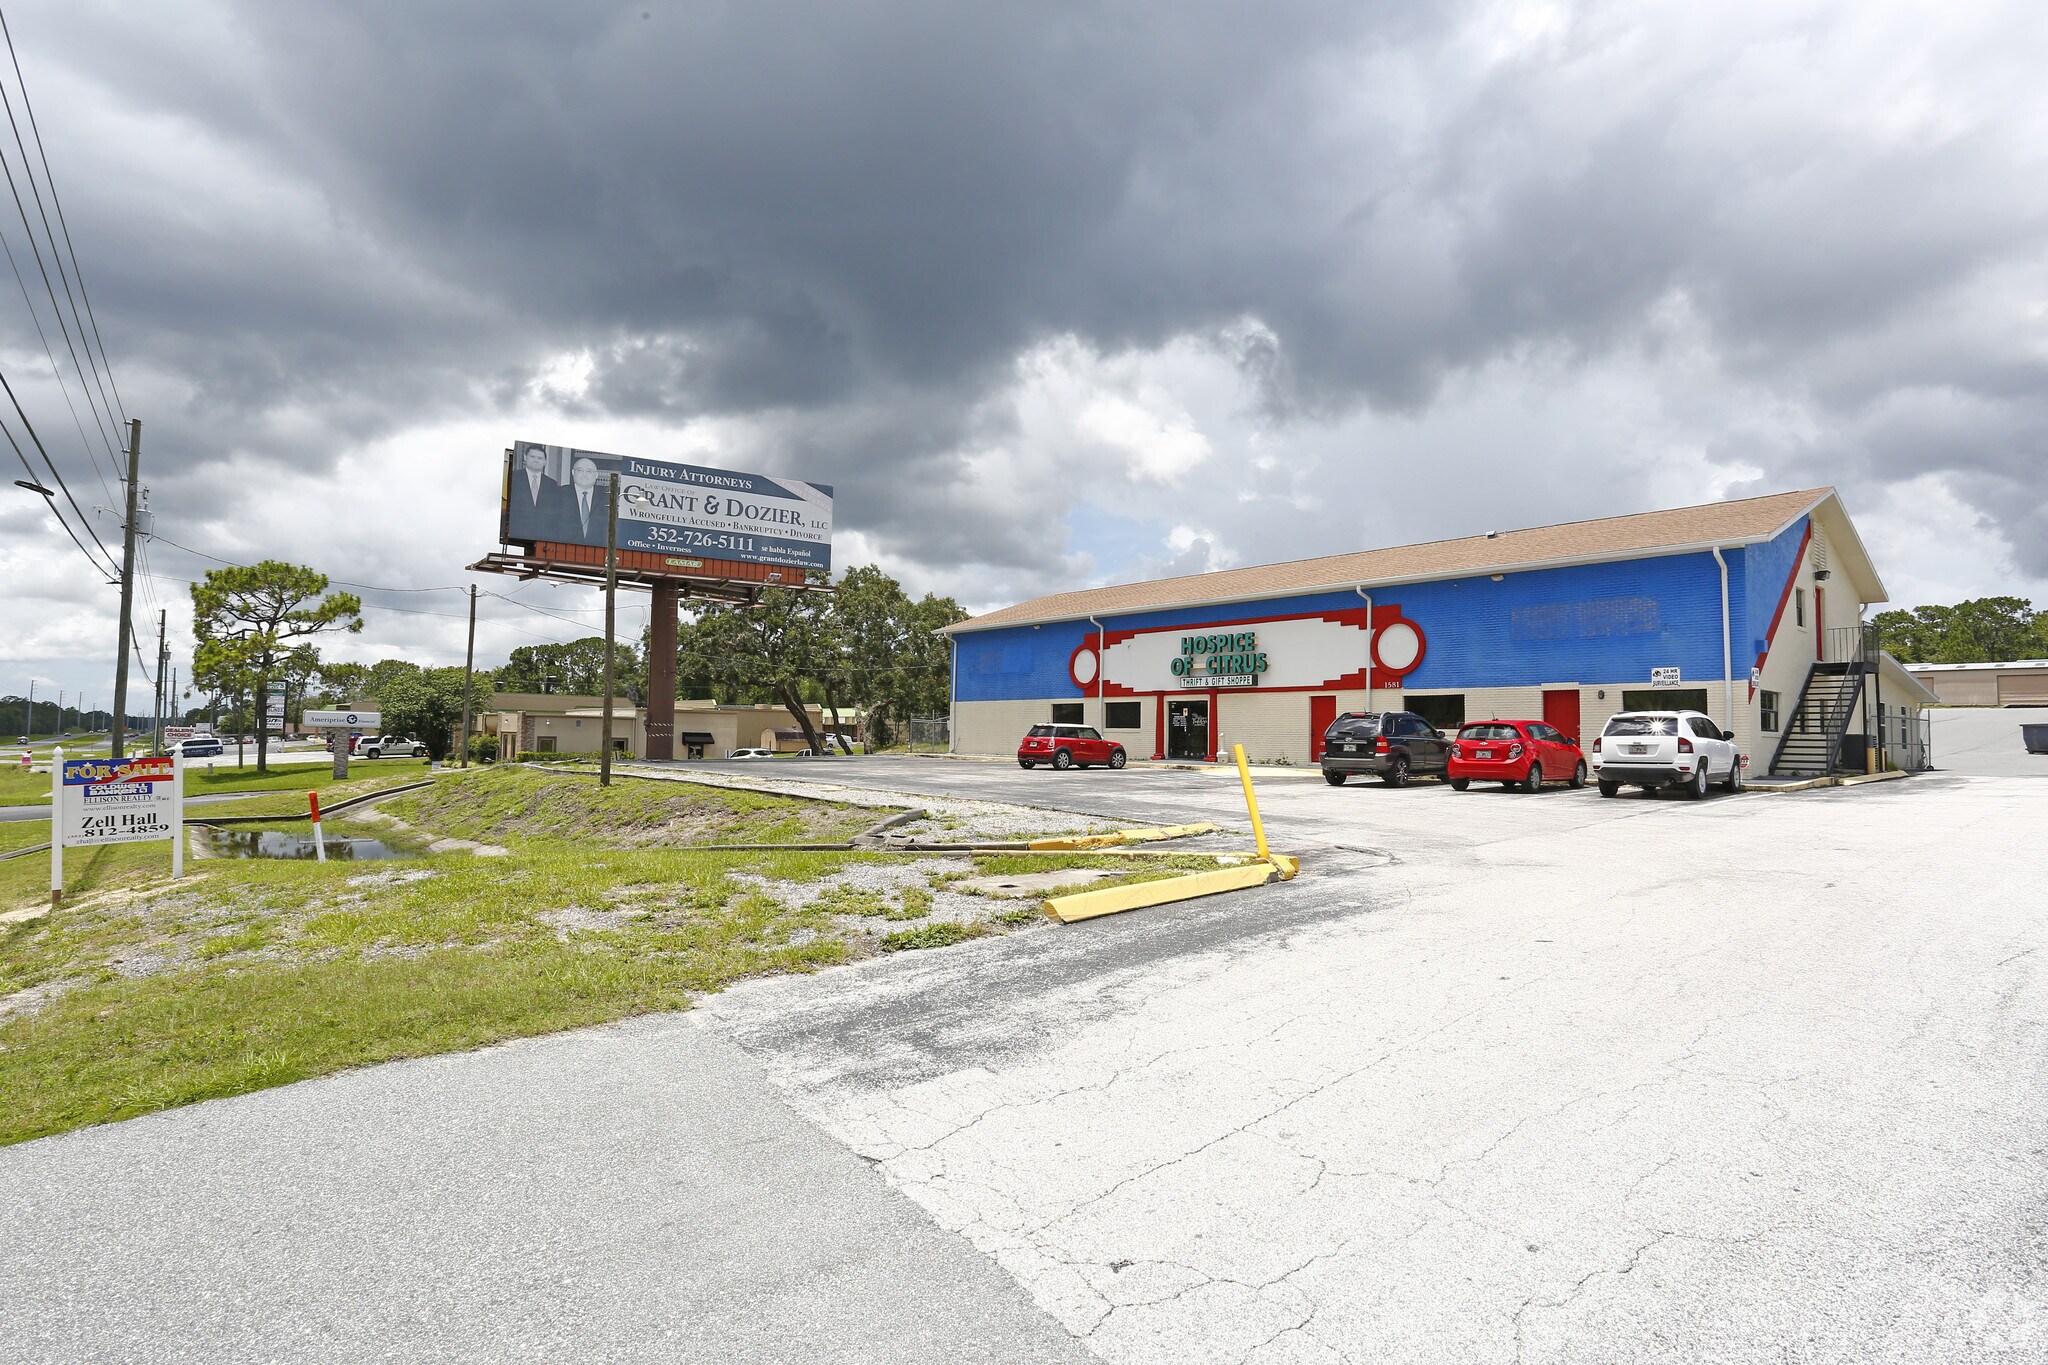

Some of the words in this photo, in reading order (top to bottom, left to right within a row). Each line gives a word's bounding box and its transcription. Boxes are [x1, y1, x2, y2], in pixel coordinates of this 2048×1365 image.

[630, 460, 676, 479] INJURY
[680, 469, 752, 489] ATTORNEYS
[704, 495, 720, 514] &
[725, 498, 806, 526] DOZIER,
[811, 520, 828, 530] LLC
[629, 508, 686, 524] WRONGFULLY
[688, 516, 726, 528] ACCUSED
[733, 521, 783, 536] BANKRUPTCY
[790, 529, 822, 540] DIVORCE
[647, 526, 754, 552] 352-726-5111
[628, 540, 650, 549] Office
[657, 544, 692, 554] Inverness
[770, 546, 786, 554] habla
[787, 547, 811, 558] Español
[740, 552, 824, 568] www.grantdozierlaw.com
[1181, 632, 1255, 655] HOSPICE
[1171, 657, 1193, 676] OF
[1206, 653, 1268, 675] CITRUS
[1182, 678, 1202, 686] THRIFT
[1204, 678, 1210, 686] &
[1212, 678, 1224, 686] GIFT
[1228, 676, 1251, 684] SHOPPE
[310, 716, 346, 724] Ameriprise
[66, 765, 112, 779] FOR
[118, 763, 170, 776] SALE
[83, 803, 156, 812] www.ellisonrealty.com
[84, 796, 119, 804] ELLISON
[82, 816, 115, 828] Zell
[122, 813, 157, 826] Hall
[84, 824, 170, 837] 812-4859
